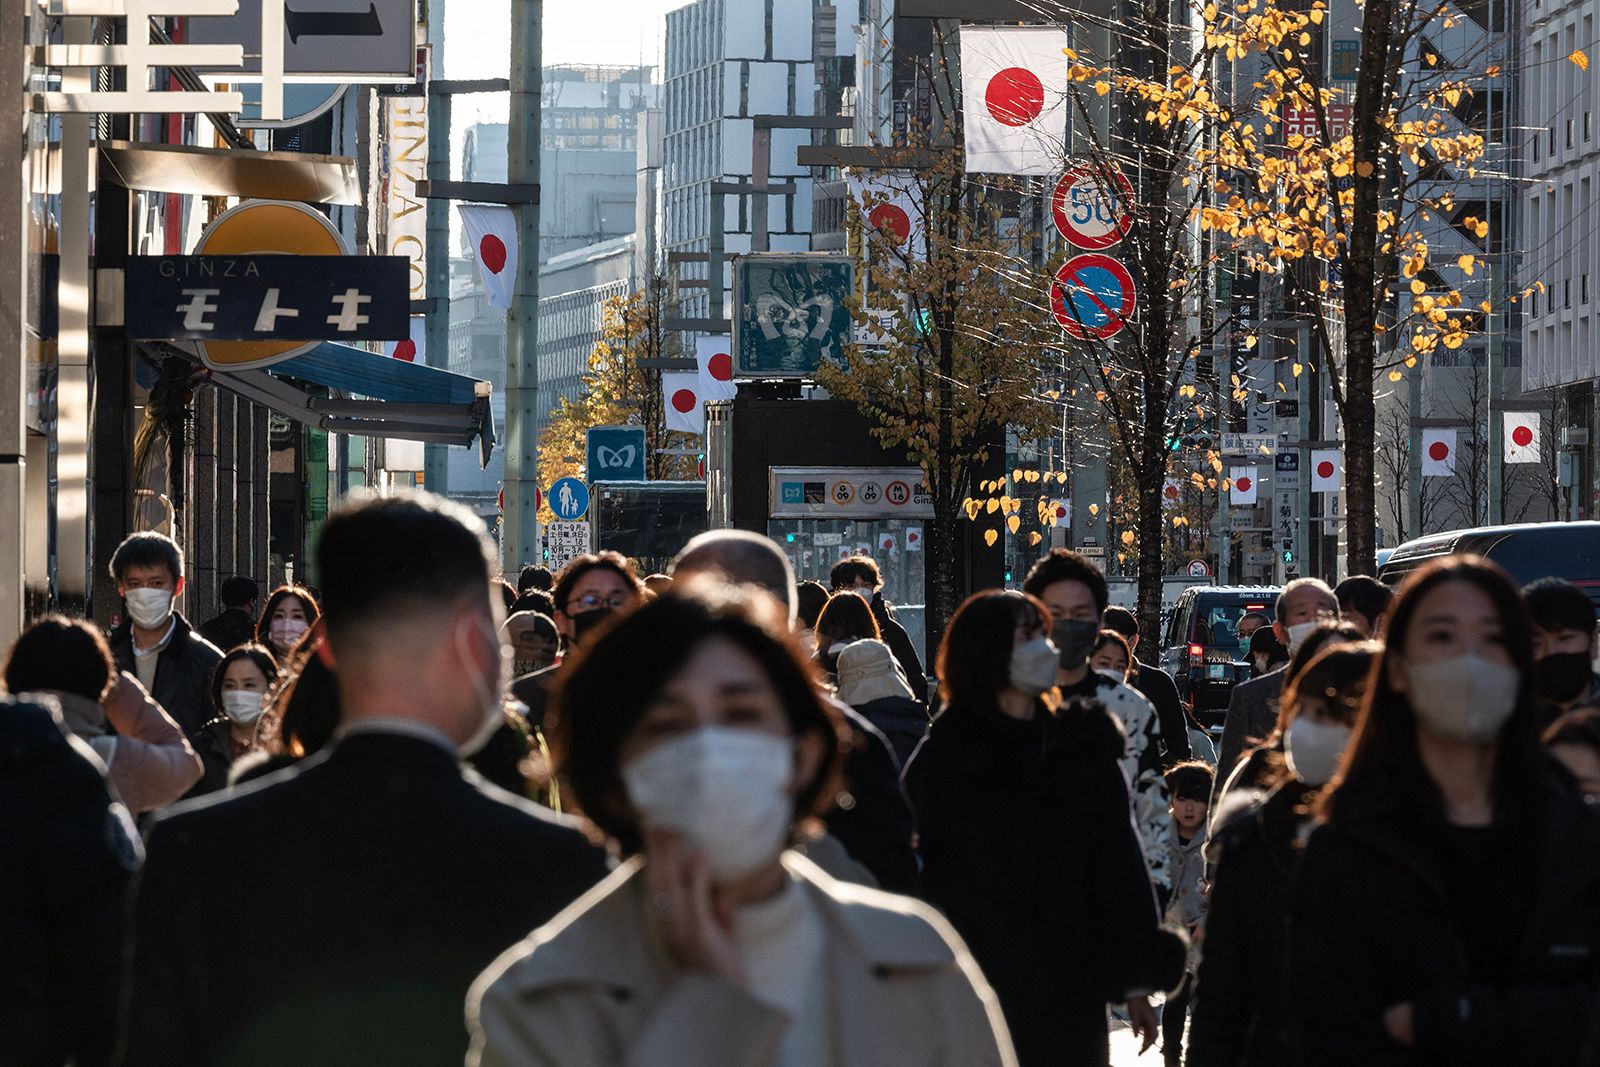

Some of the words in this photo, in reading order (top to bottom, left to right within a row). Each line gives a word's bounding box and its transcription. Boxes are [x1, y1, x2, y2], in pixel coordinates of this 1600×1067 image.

[394, 85, 409, 94] 6F
[1071, 187, 1118, 225] 50
[160, 260, 260, 278] GINZA
[175, 287, 372, 332] モトキ
[836, 492, 850, 501] 09
[864, 492, 878, 501] 09
[893, 492, 904, 501] 16
[913, 496, 933, 505] Ginz
